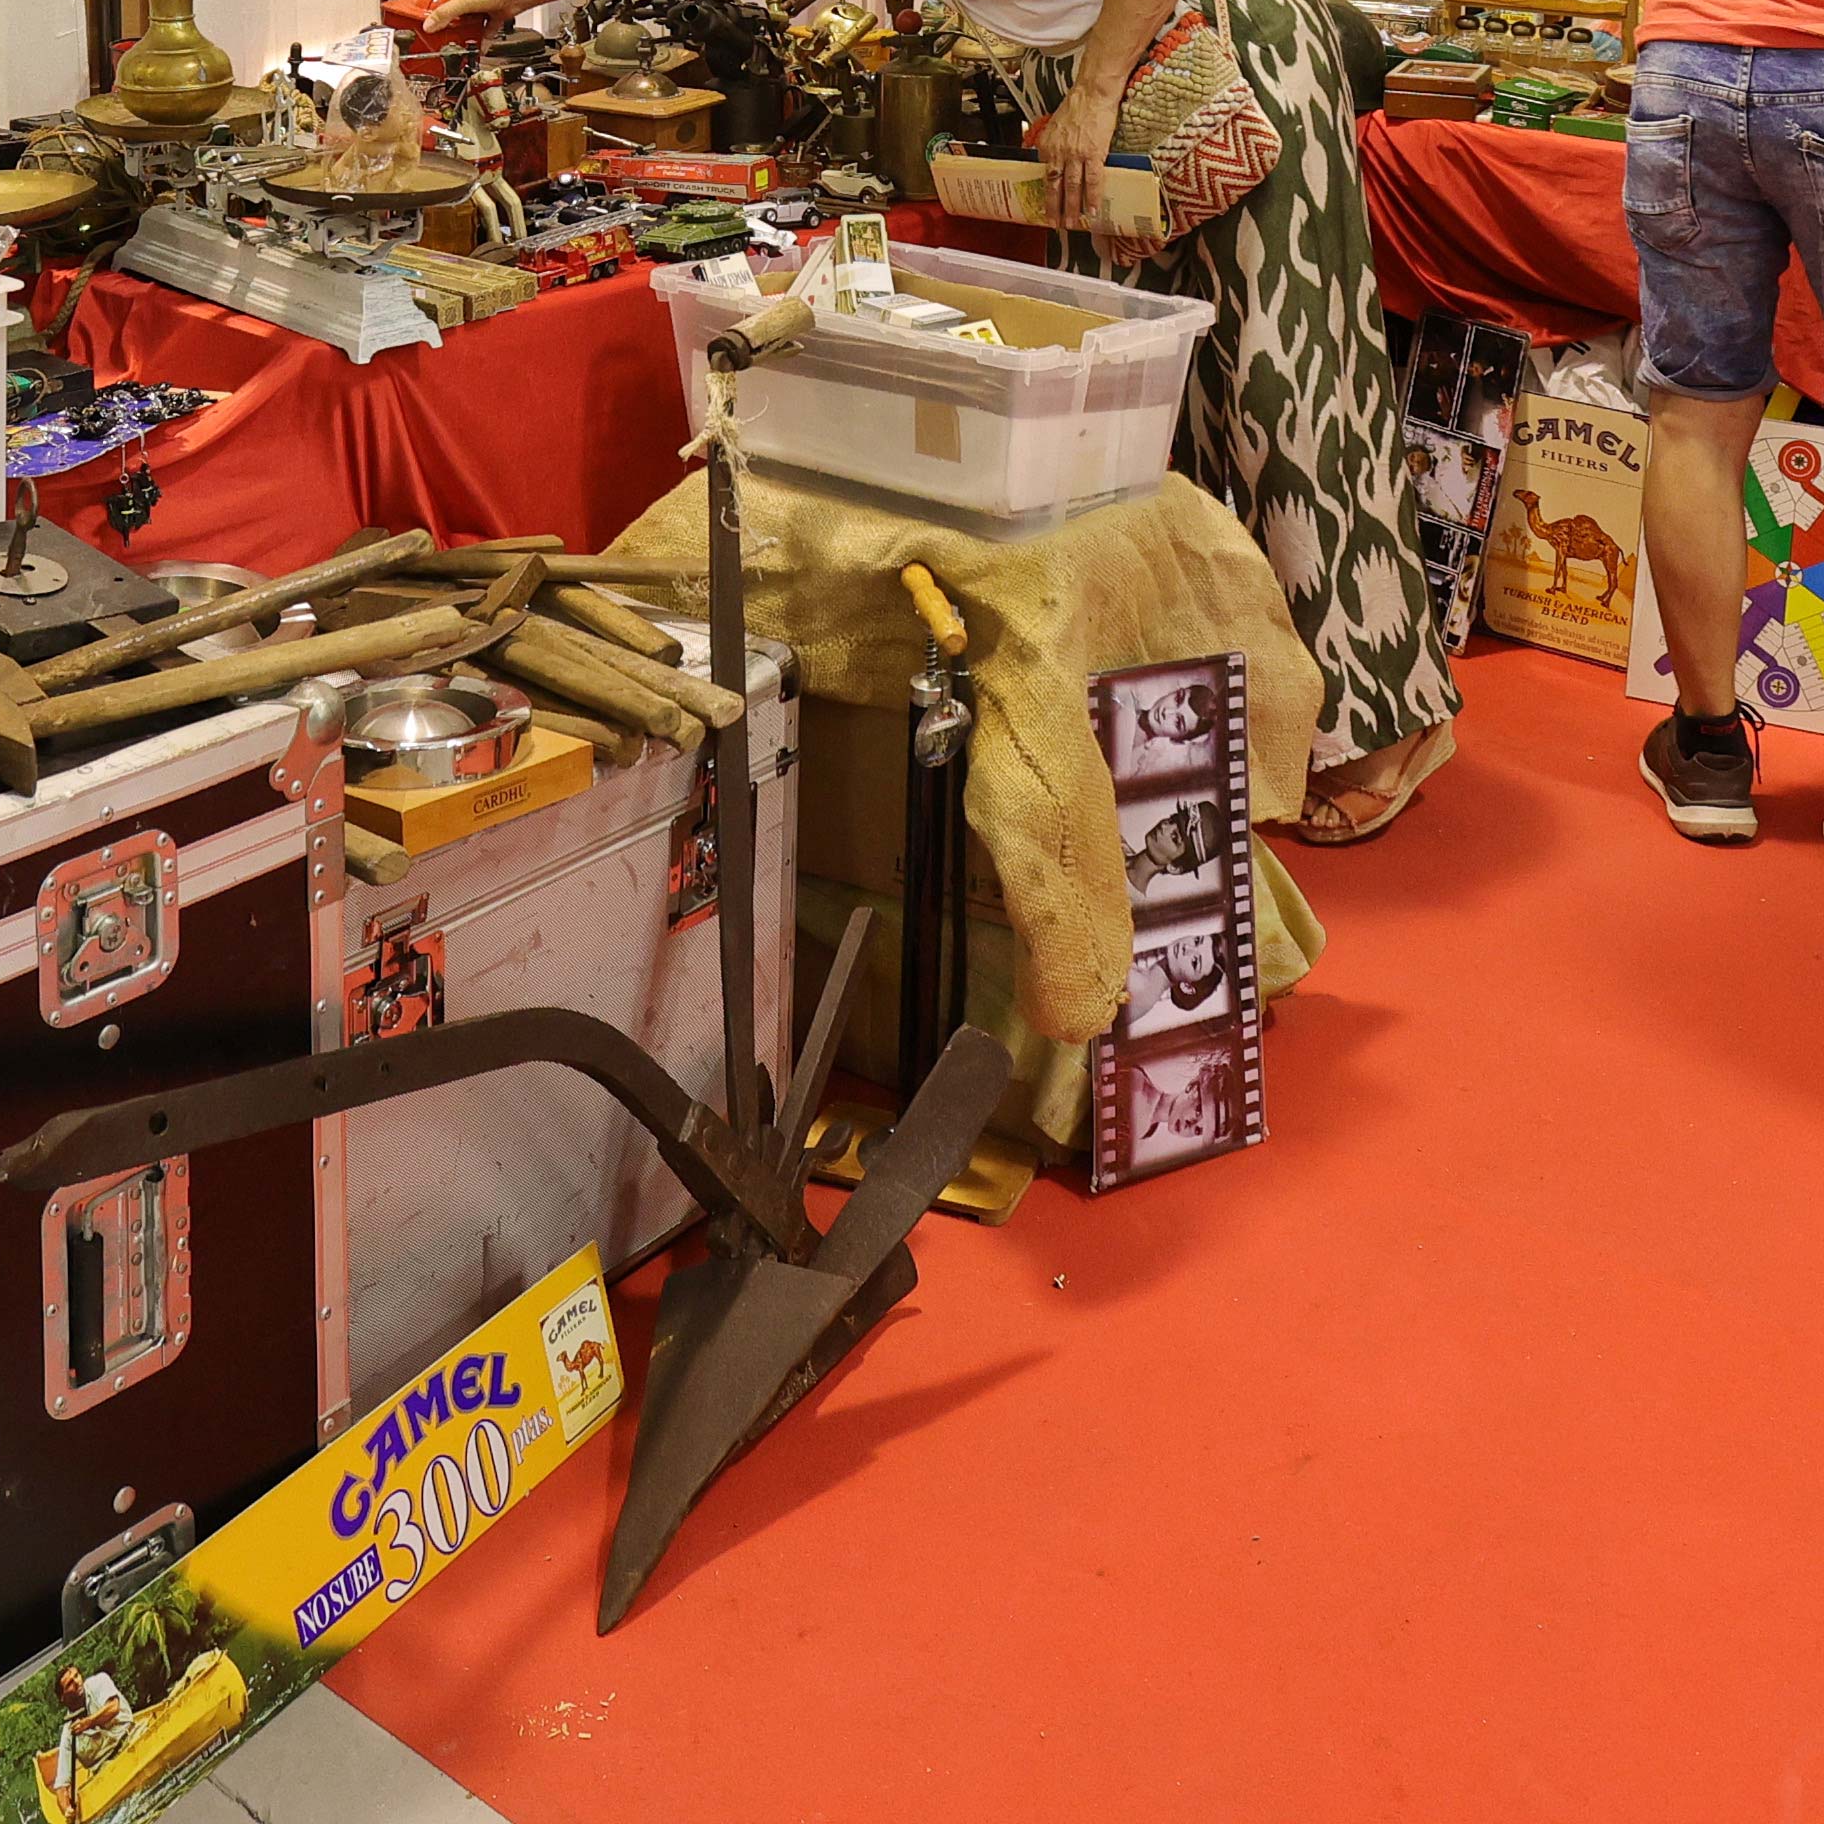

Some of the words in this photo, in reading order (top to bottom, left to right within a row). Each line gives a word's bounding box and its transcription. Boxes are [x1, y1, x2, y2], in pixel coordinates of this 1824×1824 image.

[673, 183, 704, 191] CRASH
[706, 185, 736, 195] TRUCK
[1512, 418, 1641, 472] CAMEL
[1541, 449, 1608, 472] FILTERS
[1503, 585, 1552, 606] TURKISH
[1564, 602, 1629, 626] AMERICAN
[1541, 606, 1590, 626] BLEND
[473, 783, 527, 814] CARDHU
[548, 1298, 598, 1345] CAMEL
[327, 1351, 521, 1539] CAMEL
[375, 1417, 513, 1604] 300
[510, 1405, 554, 1467] ptas.
[296, 1596, 331, 1646] NO
[328, 1550, 382, 1618] SUBE
